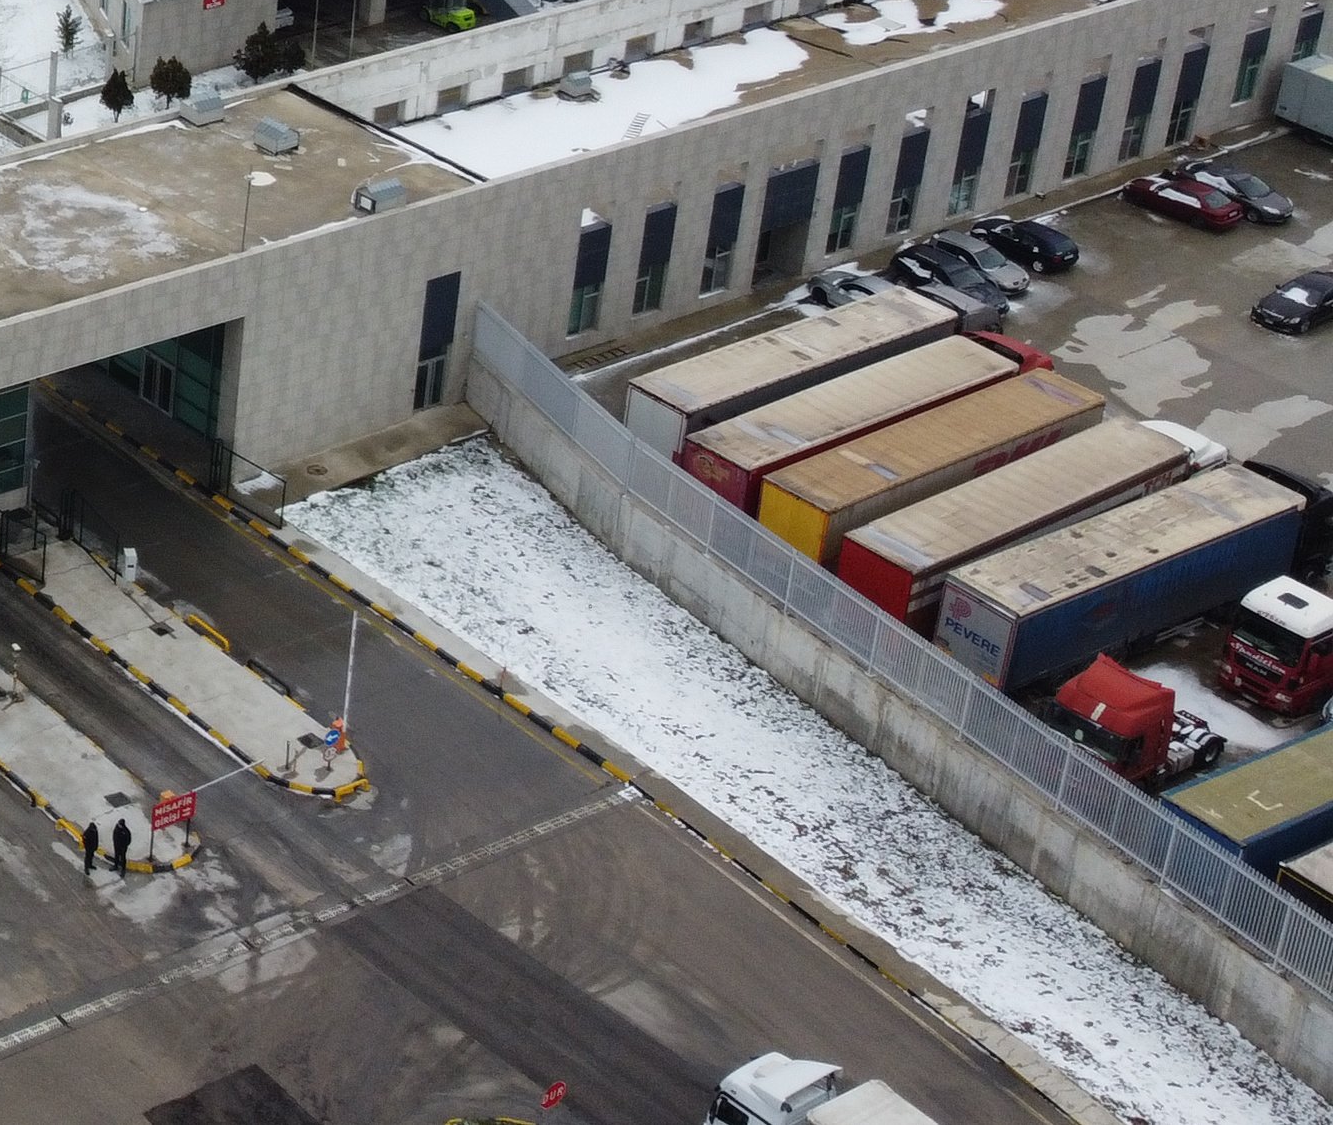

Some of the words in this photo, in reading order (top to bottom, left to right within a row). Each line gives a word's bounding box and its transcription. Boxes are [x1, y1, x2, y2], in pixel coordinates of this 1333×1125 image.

[944, 616, 1002, 658] PEVERE
[154, 795, 193, 817] MİSAFİR
[543, 1086, 564, 1105] DUR
